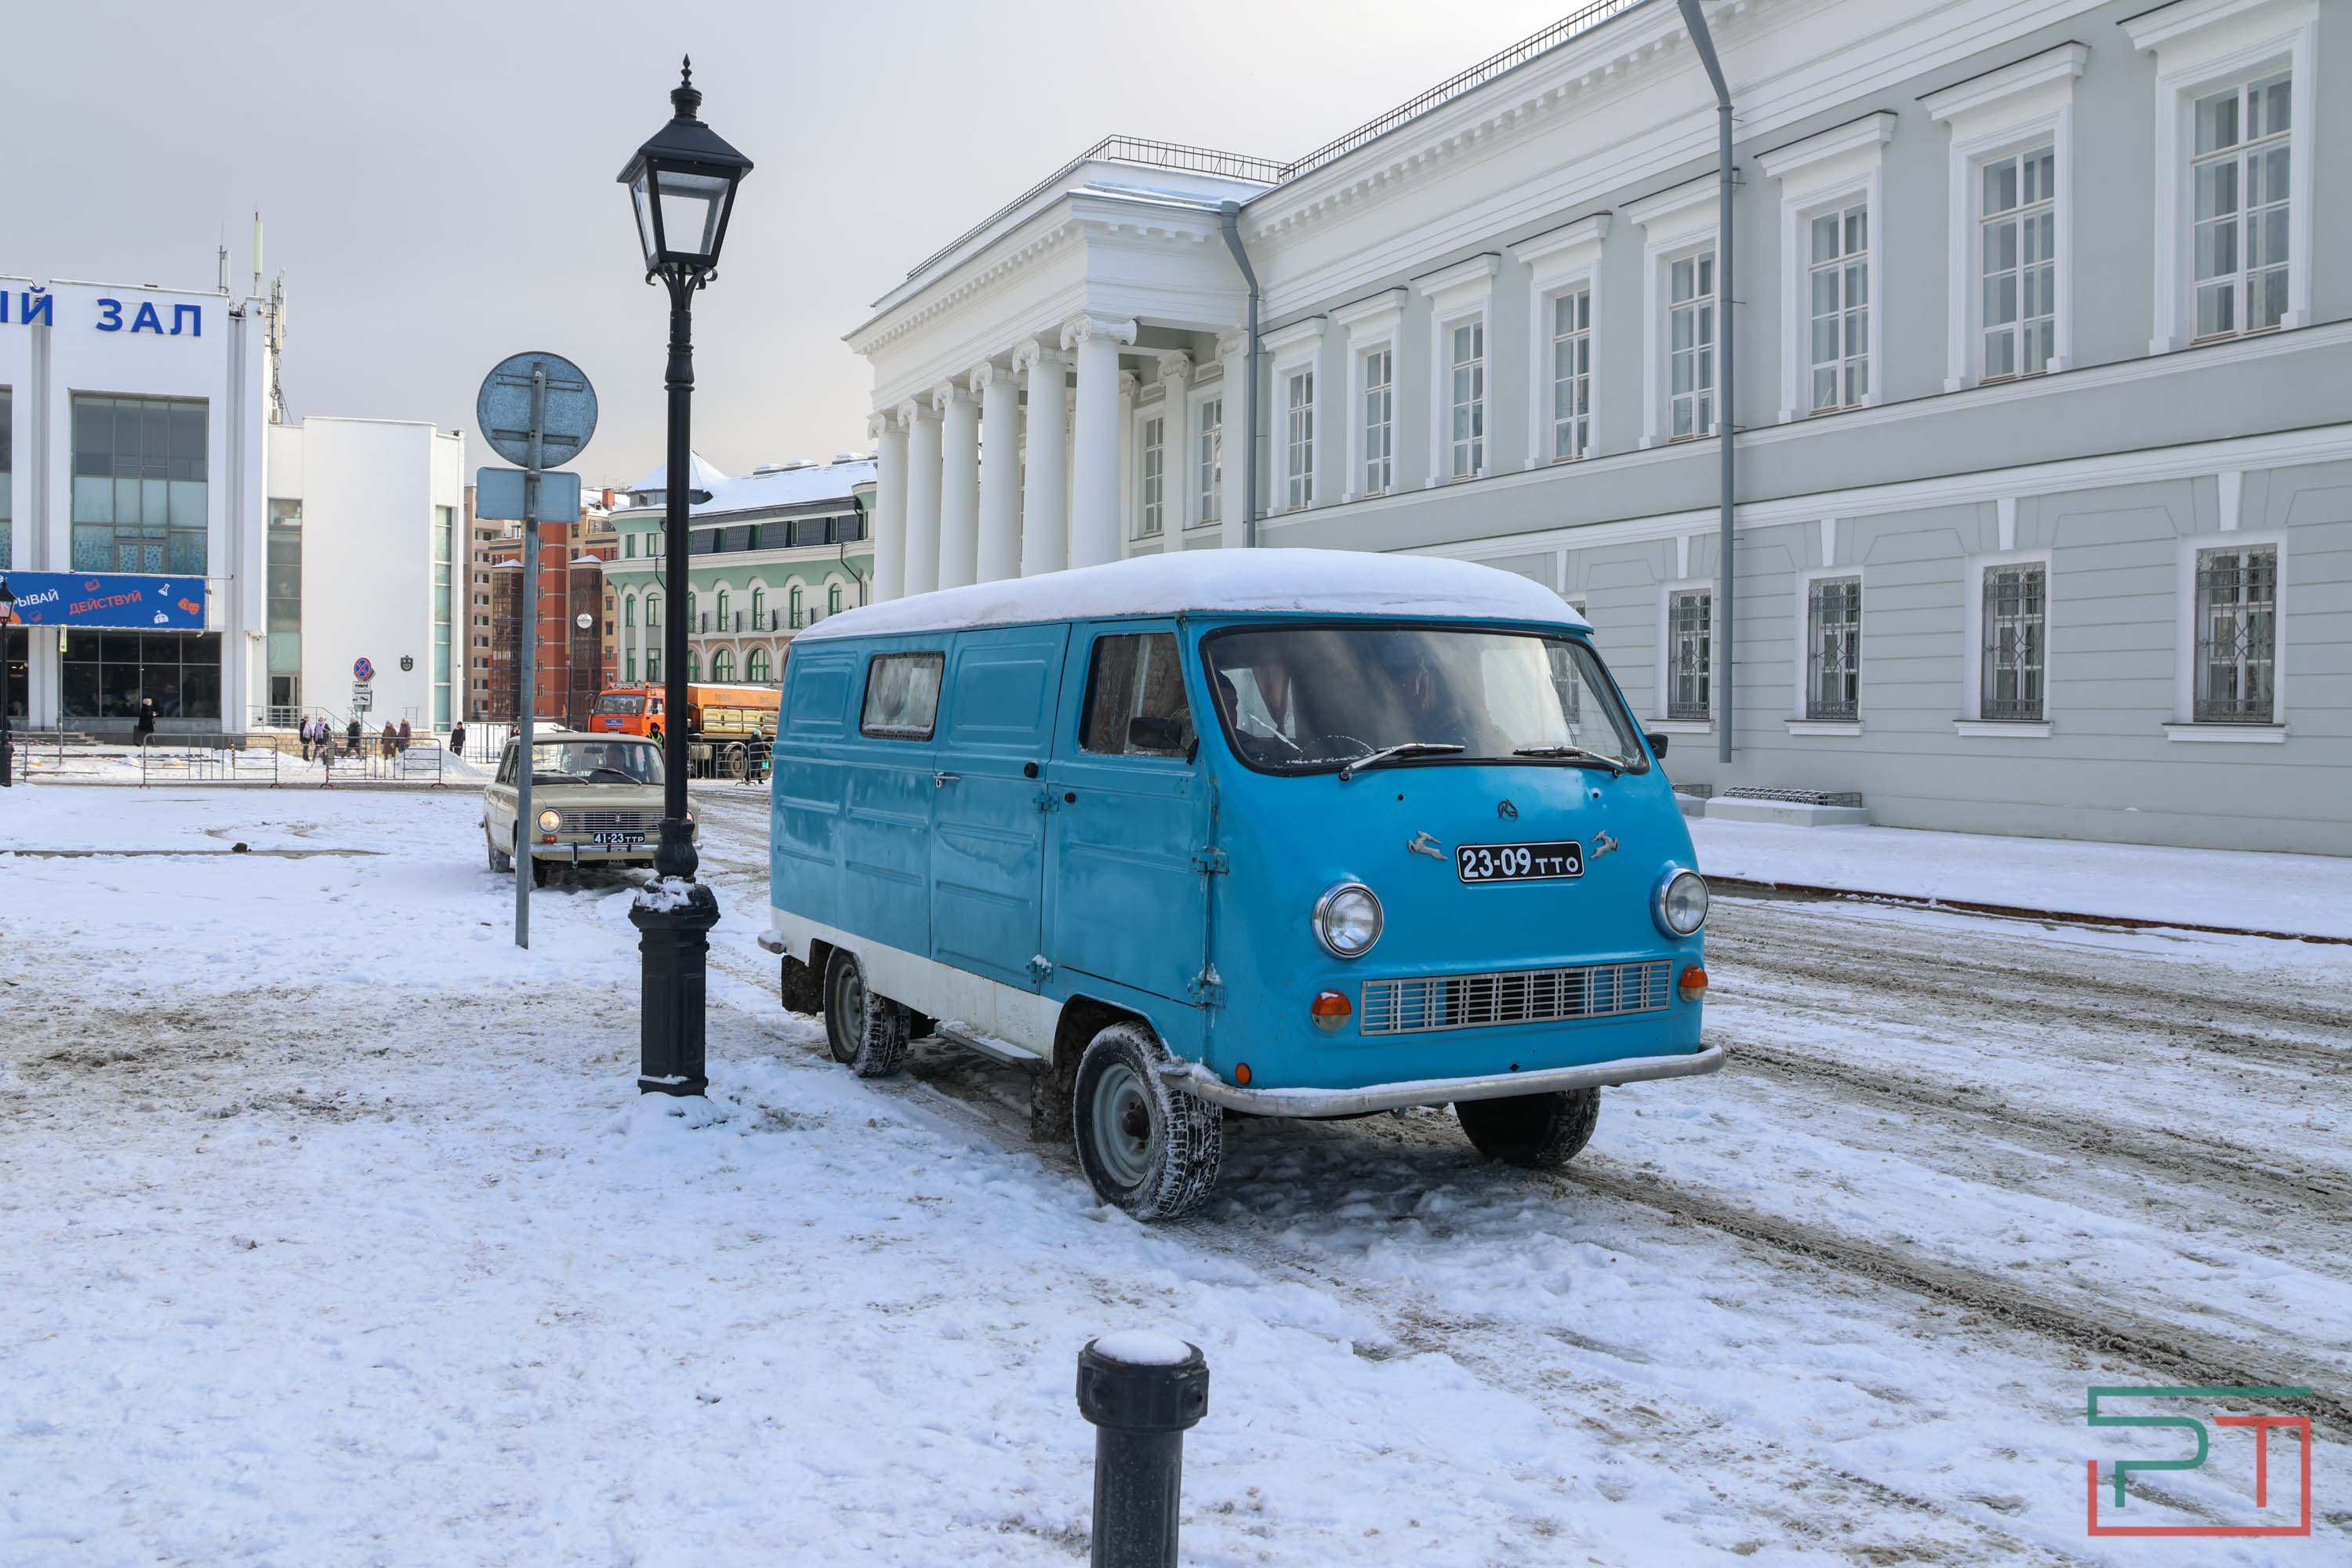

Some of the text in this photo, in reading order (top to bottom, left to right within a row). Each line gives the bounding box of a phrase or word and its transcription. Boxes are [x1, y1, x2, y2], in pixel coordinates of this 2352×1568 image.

[96, 298, 201, 336] ЗАЛ
[13, 588, 59, 608] ЫВАЙ
[69, 590, 143, 615] ДЕЙСТВУЙ
[594, 833, 624, 844] 41-23
[1462, 848, 1531, 878] 23-09
